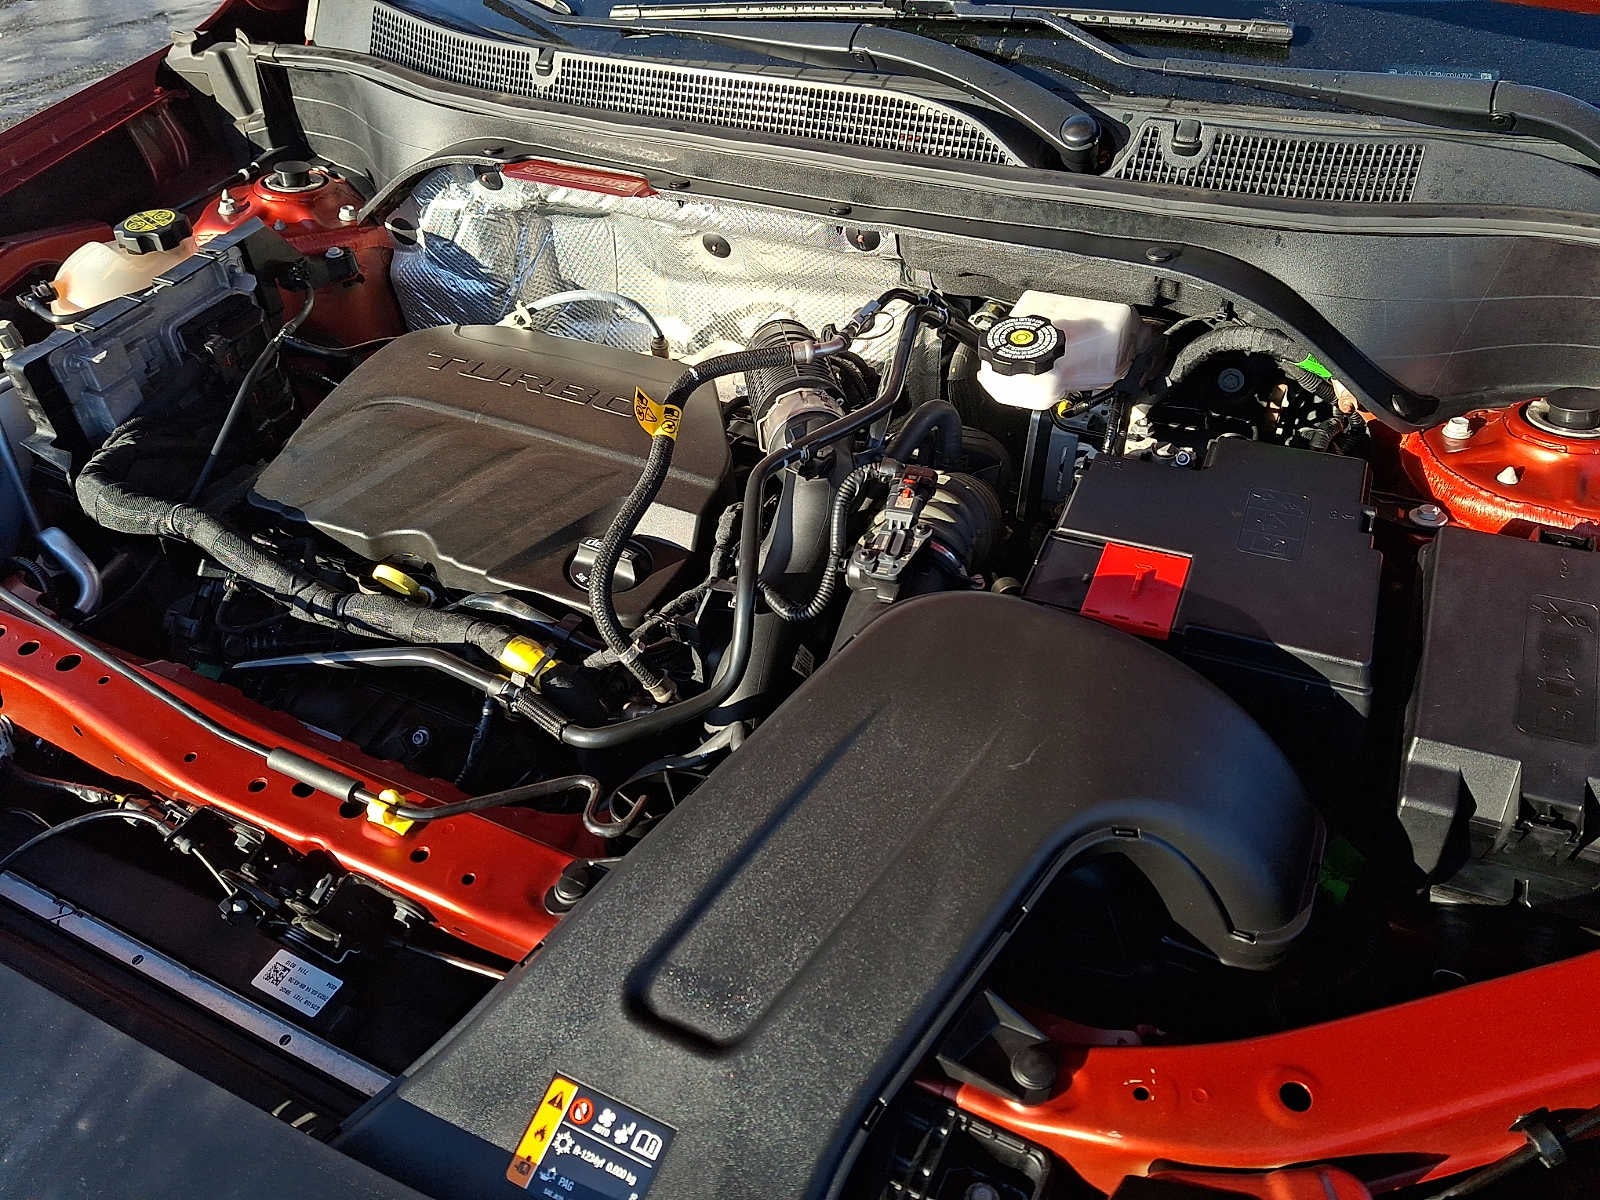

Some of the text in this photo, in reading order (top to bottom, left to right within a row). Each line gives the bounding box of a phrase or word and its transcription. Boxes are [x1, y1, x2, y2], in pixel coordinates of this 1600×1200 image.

[427, 350, 634, 418] TURBO
[591, 1122, 611, 1138] AUTO
[572, 1144, 607, 1169] R-1234yf
[624, 1172, 637, 1187] kg
[558, 1176, 575, 1191] PAG
